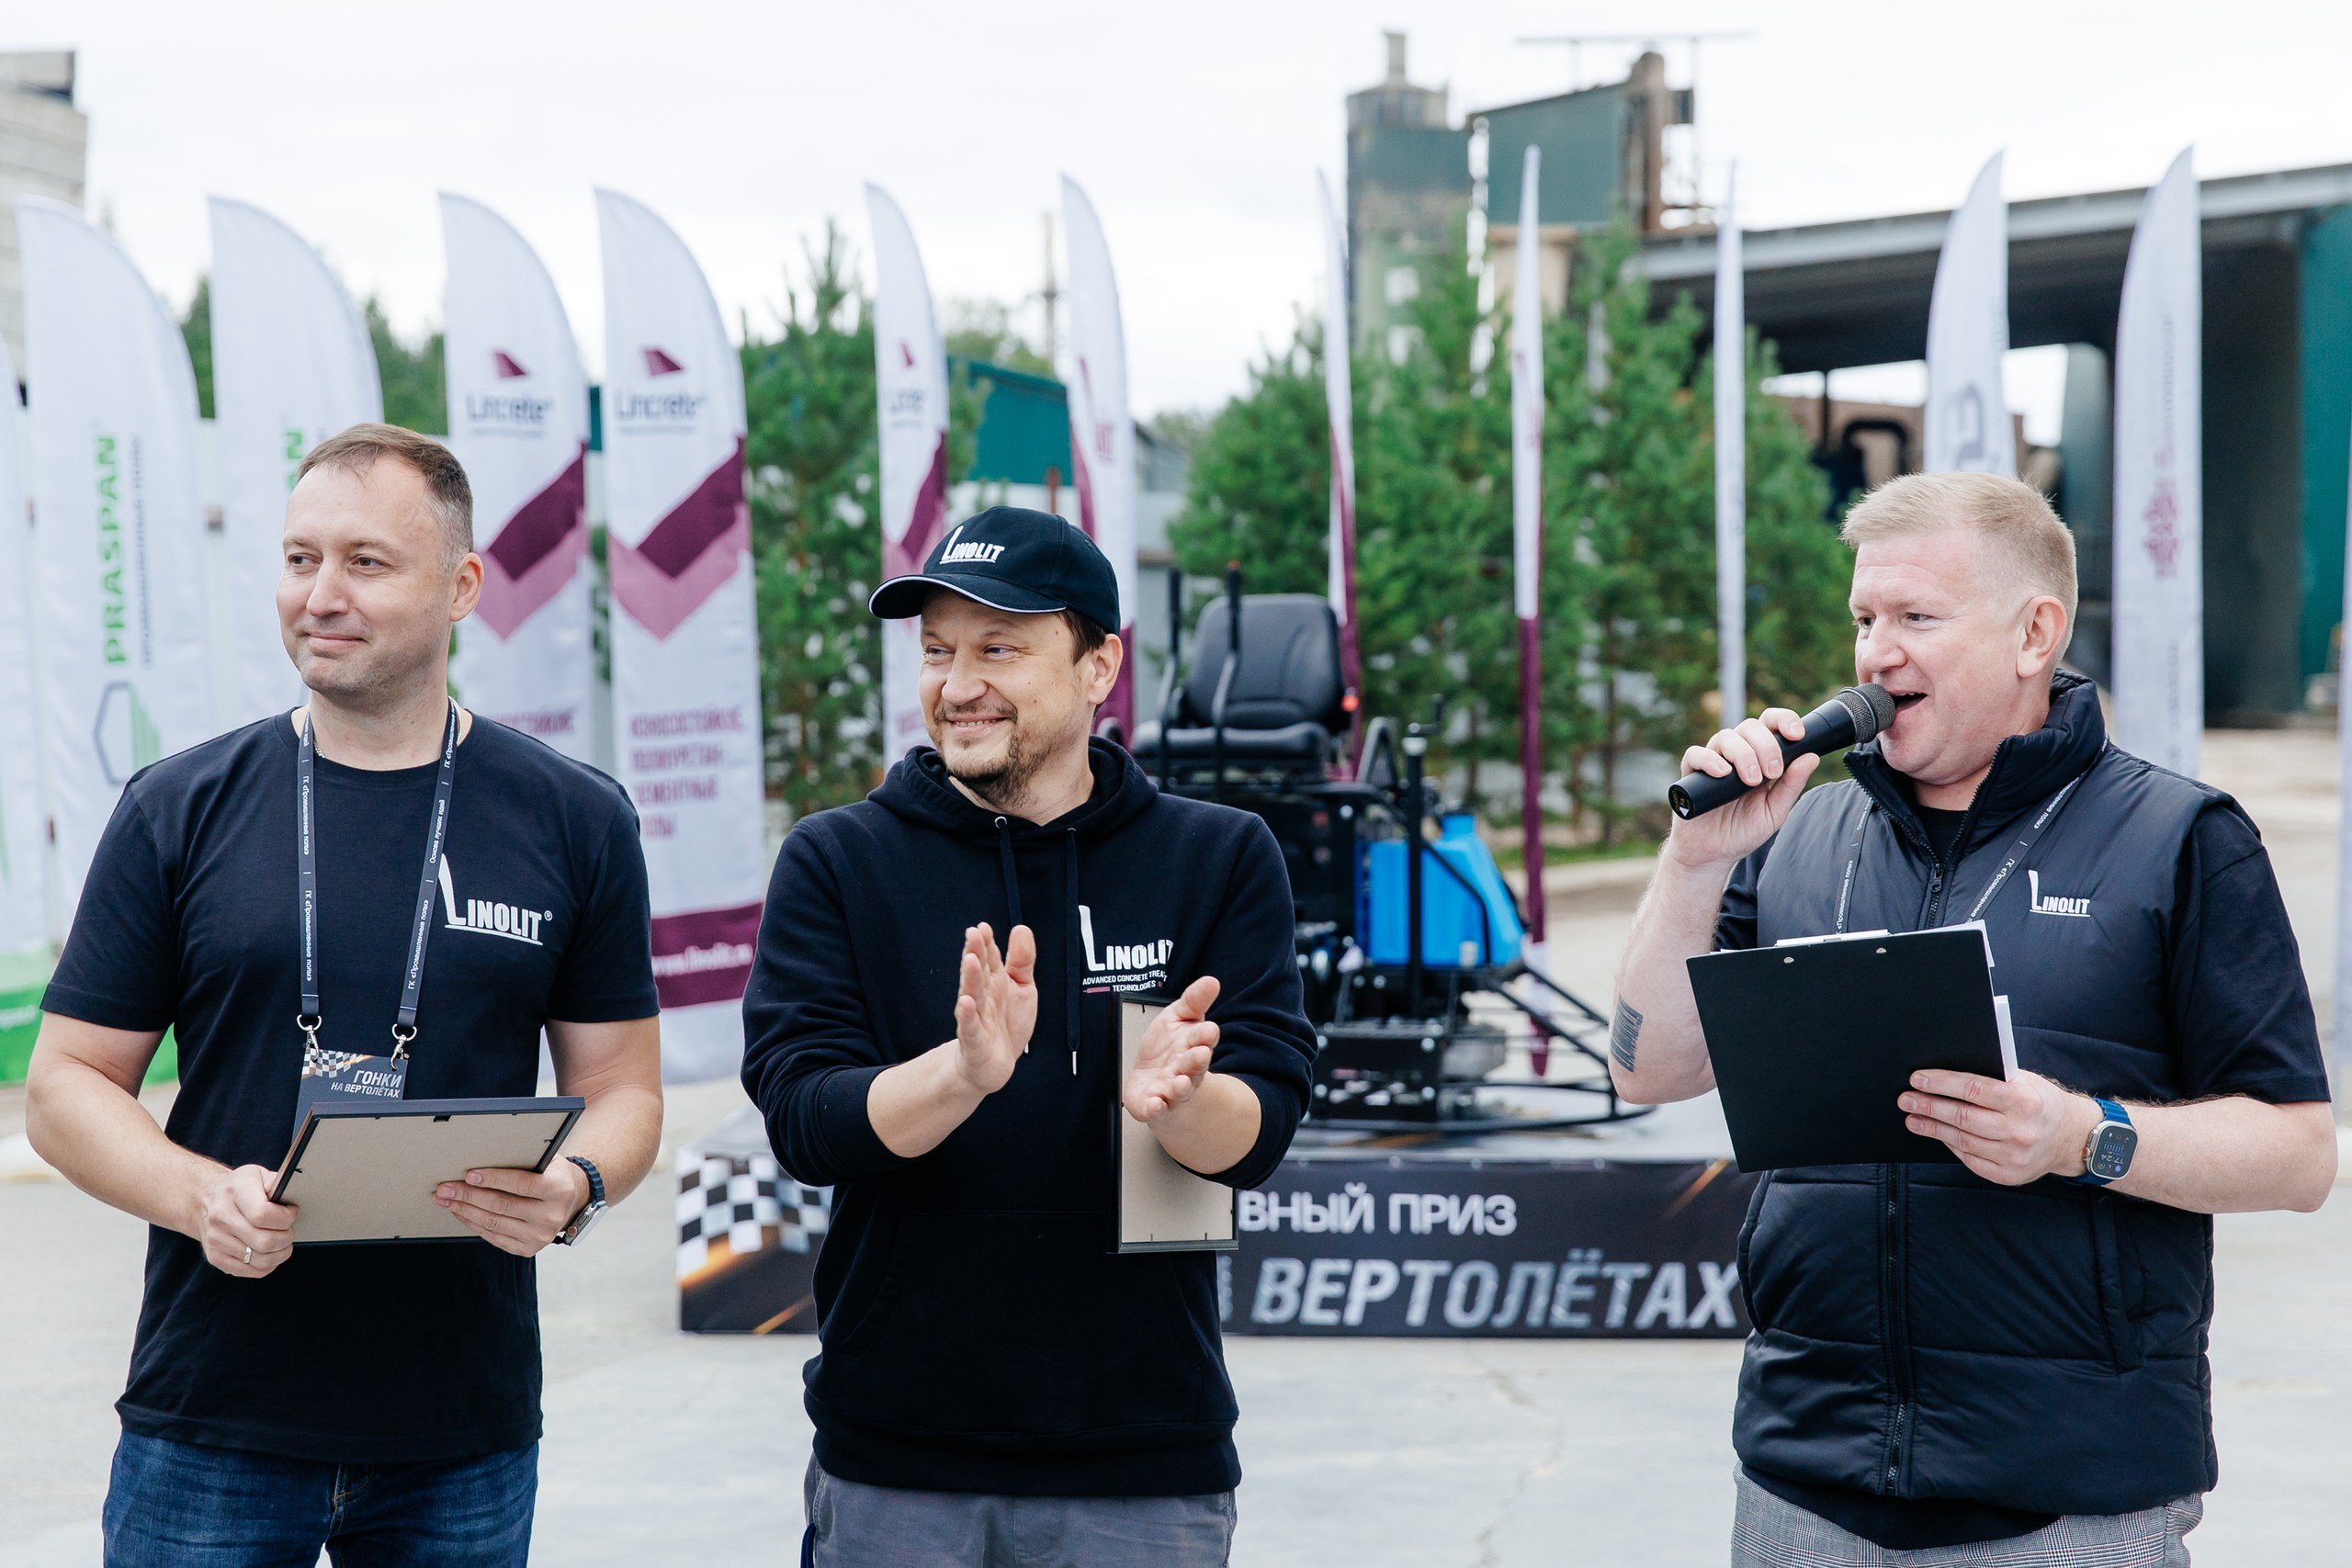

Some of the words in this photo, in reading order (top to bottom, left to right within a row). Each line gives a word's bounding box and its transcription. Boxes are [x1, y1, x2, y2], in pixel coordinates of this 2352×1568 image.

[96, 434, 129, 666] PRASPAN
[940, 525, 1005, 562] LINOLIT
[2006, 858, 2016, 868] ГК
[304, 889, 312, 899] ГК
[2028, 869, 2091, 915] LINOLIT
[407, 980, 416, 990] ГК
[1082, 975, 1117, 986] ADVANCED
[1116, 972, 1148, 983] CONCRETE
[1112, 979, 1157, 992] TECHNOLOGIES
[353, 1069, 402, 1089] ГОНКИ
[331, 1082, 344, 1091] НА
[344, 1083, 401, 1099] ВЕРТОЛЁТАХ
[2101, 1154, 2124, 1165] 17:24
[1387, 1192, 1519, 1236] ПРИЗ
[1250, 1247, 1738, 1330] ВЕРТОЛЁТАХ
